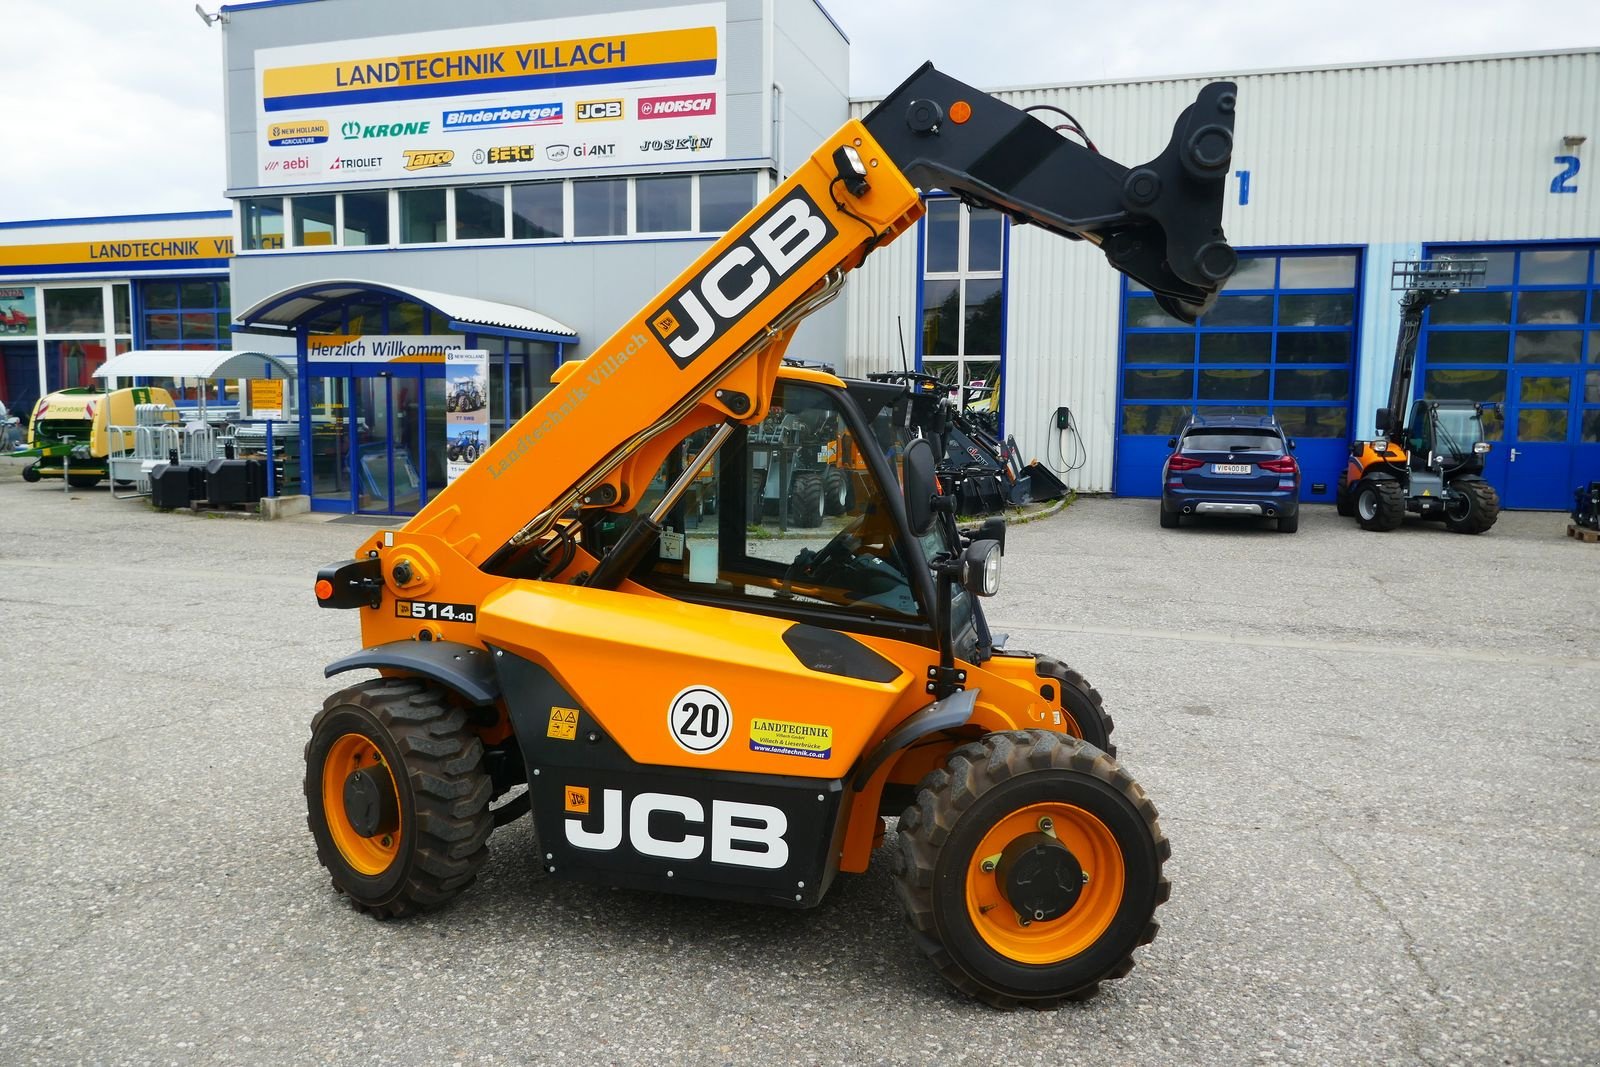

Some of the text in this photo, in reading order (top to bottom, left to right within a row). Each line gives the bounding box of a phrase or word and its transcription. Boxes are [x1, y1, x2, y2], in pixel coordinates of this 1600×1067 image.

[336, 40, 626, 87] LANDTECHNIK VILLACH
[446, 106, 561, 124] Binderberger
[578, 102, 622, 119] JCB
[653, 98, 712, 115] HORSCH
[296, 126, 324, 134] HOLLAND
[363, 121, 431, 138] KRONE
[281, 137, 315, 145] AGRICULTURE
[639, 135, 713, 151] JOSKIN
[283, 156, 309, 170] aebi
[340, 157, 383, 168] TRIOLIET
[405, 150, 453, 169] Tanco
[1550, 155, 1581, 193] 2
[1235, 170, 1250, 206] 1
[89, 240, 199, 259] LANDTECHNIK
[668, 198, 827, 358] JCB
[311, 340, 365, 356] Herzlich
[486, 330, 650, 479] Landtechnik-Villach
[412, 602, 474, 622] 514-40
[680, 702, 720, 738] 20
[753, 721, 829, 738] LANDTECHNIK
[754, 744, 826, 758] www.landtechnik.co.at
[785, 740, 822, 749] Lieserbrücke
[570, 792, 586, 805] JCB
[564, 788, 790, 869] JCB
